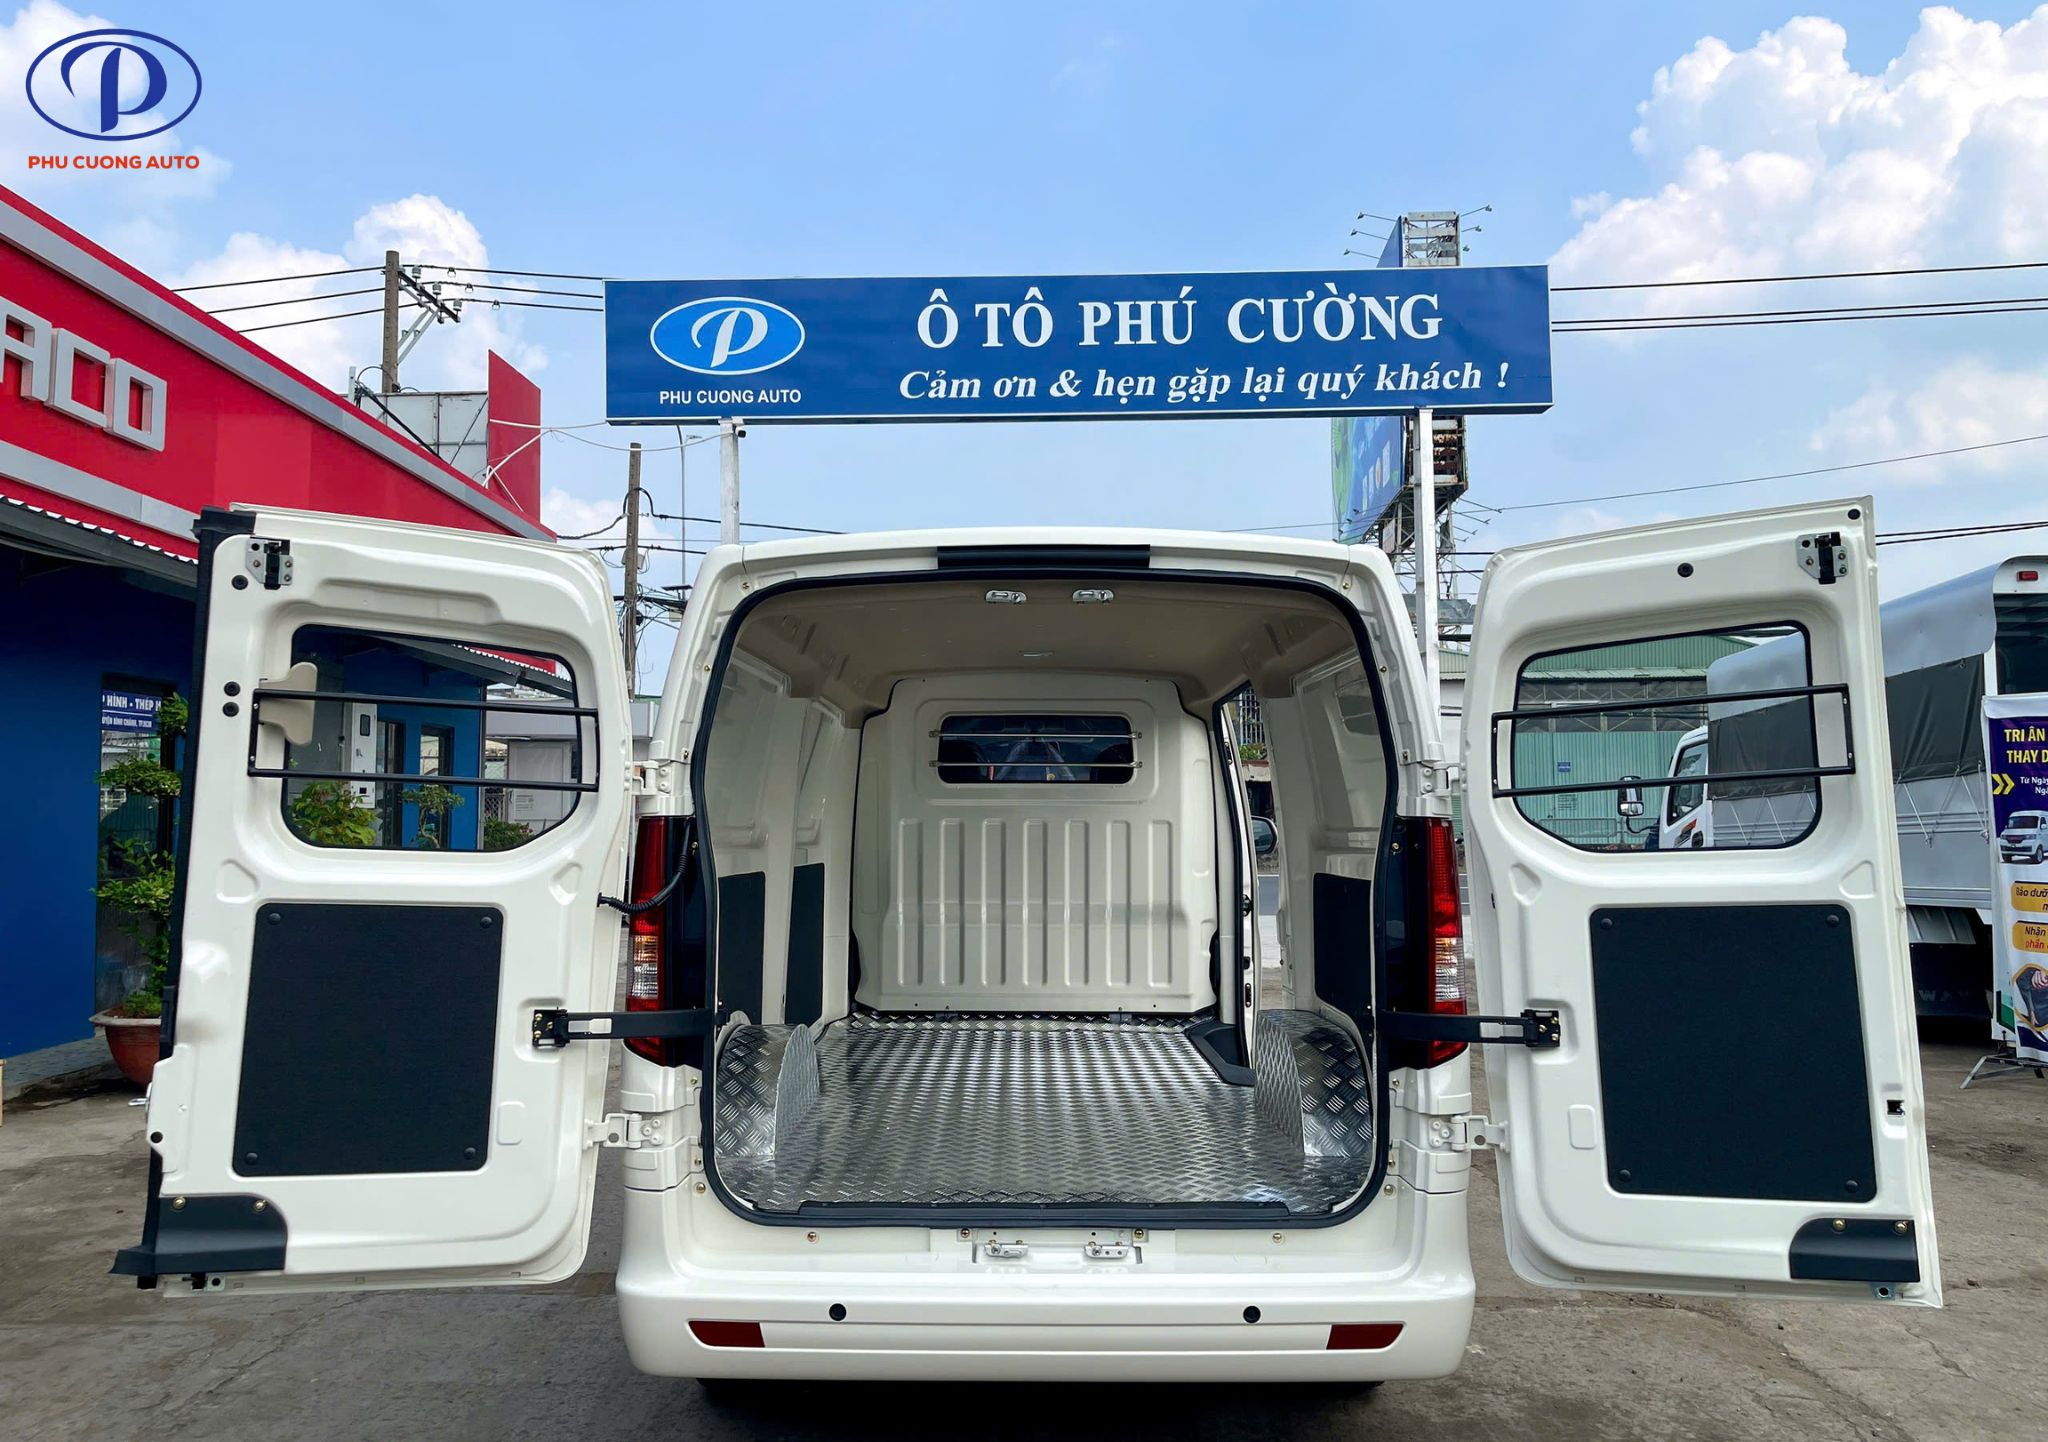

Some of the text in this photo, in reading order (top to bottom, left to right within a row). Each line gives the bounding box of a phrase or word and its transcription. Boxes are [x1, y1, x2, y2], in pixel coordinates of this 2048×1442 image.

[917, 282, 1443, 349] Ô TÔ PHÚ CƯỜNG
[900, 369, 981, 399] Cảm
[993, 374, 1037, 398] ơn
[1050, 369, 1081, 397] &
[1093, 368, 1155, 404] hẹn
[1167, 368, 1231, 403] gặp
[1241, 366, 1285, 402] lại
[1297, 363, 1364, 399] quý
[1374, 361, 1482, 392] khách
[659, 389, 801, 404] PHU CUONG AUTO
[2004, 725, 2046, 742] TRI ÂN
[2006, 749, 2039, 764] THAY
